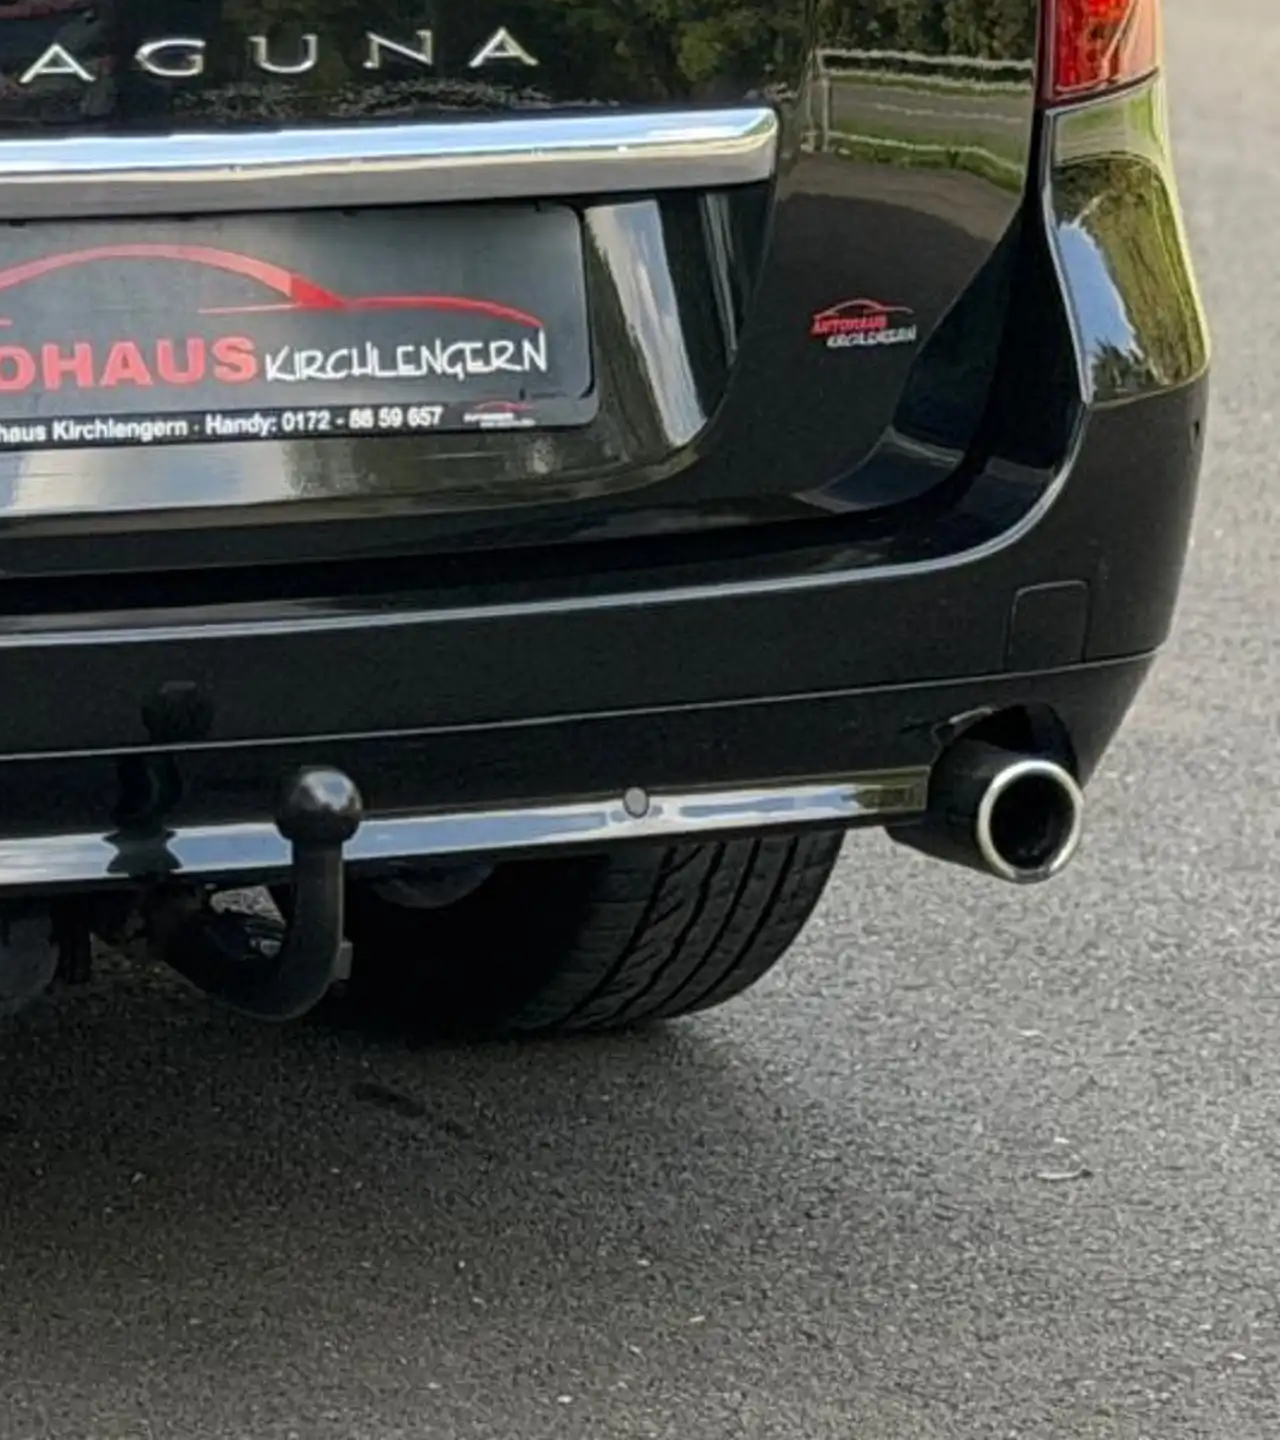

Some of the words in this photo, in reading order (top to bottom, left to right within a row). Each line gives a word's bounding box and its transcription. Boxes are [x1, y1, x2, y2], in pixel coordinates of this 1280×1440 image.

[265, 328, 547, 381] KIRCHLENGERN
[52, 417, 188, 441] Kirchlengern
[205, 412, 278, 437] Handy:
[281, 410, 330, 432] 0172
